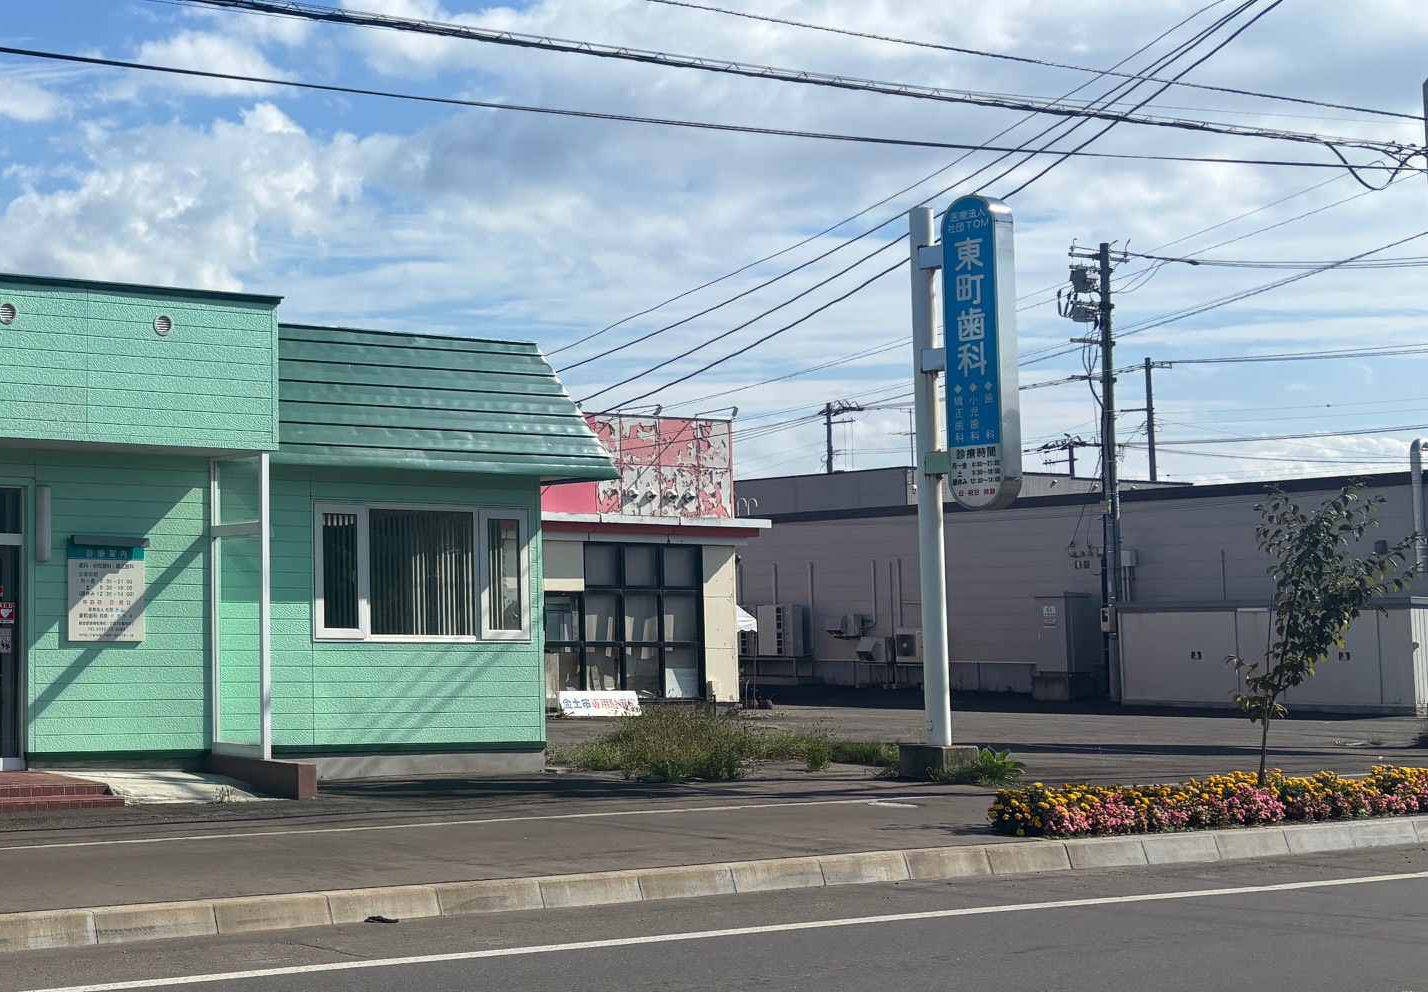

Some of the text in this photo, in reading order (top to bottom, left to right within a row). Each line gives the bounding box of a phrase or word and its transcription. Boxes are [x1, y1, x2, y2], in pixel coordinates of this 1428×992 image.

[950, 207, 986, 222] 医療法人
[954, 236, 988, 378] 東町歯科
[954, 396, 964, 442] 矯正歯科
[970, 394, 980, 440] 小児歯科
[956, 446, 996, 460] 診療時間
[86, 549, 128, 558] 診療案内
